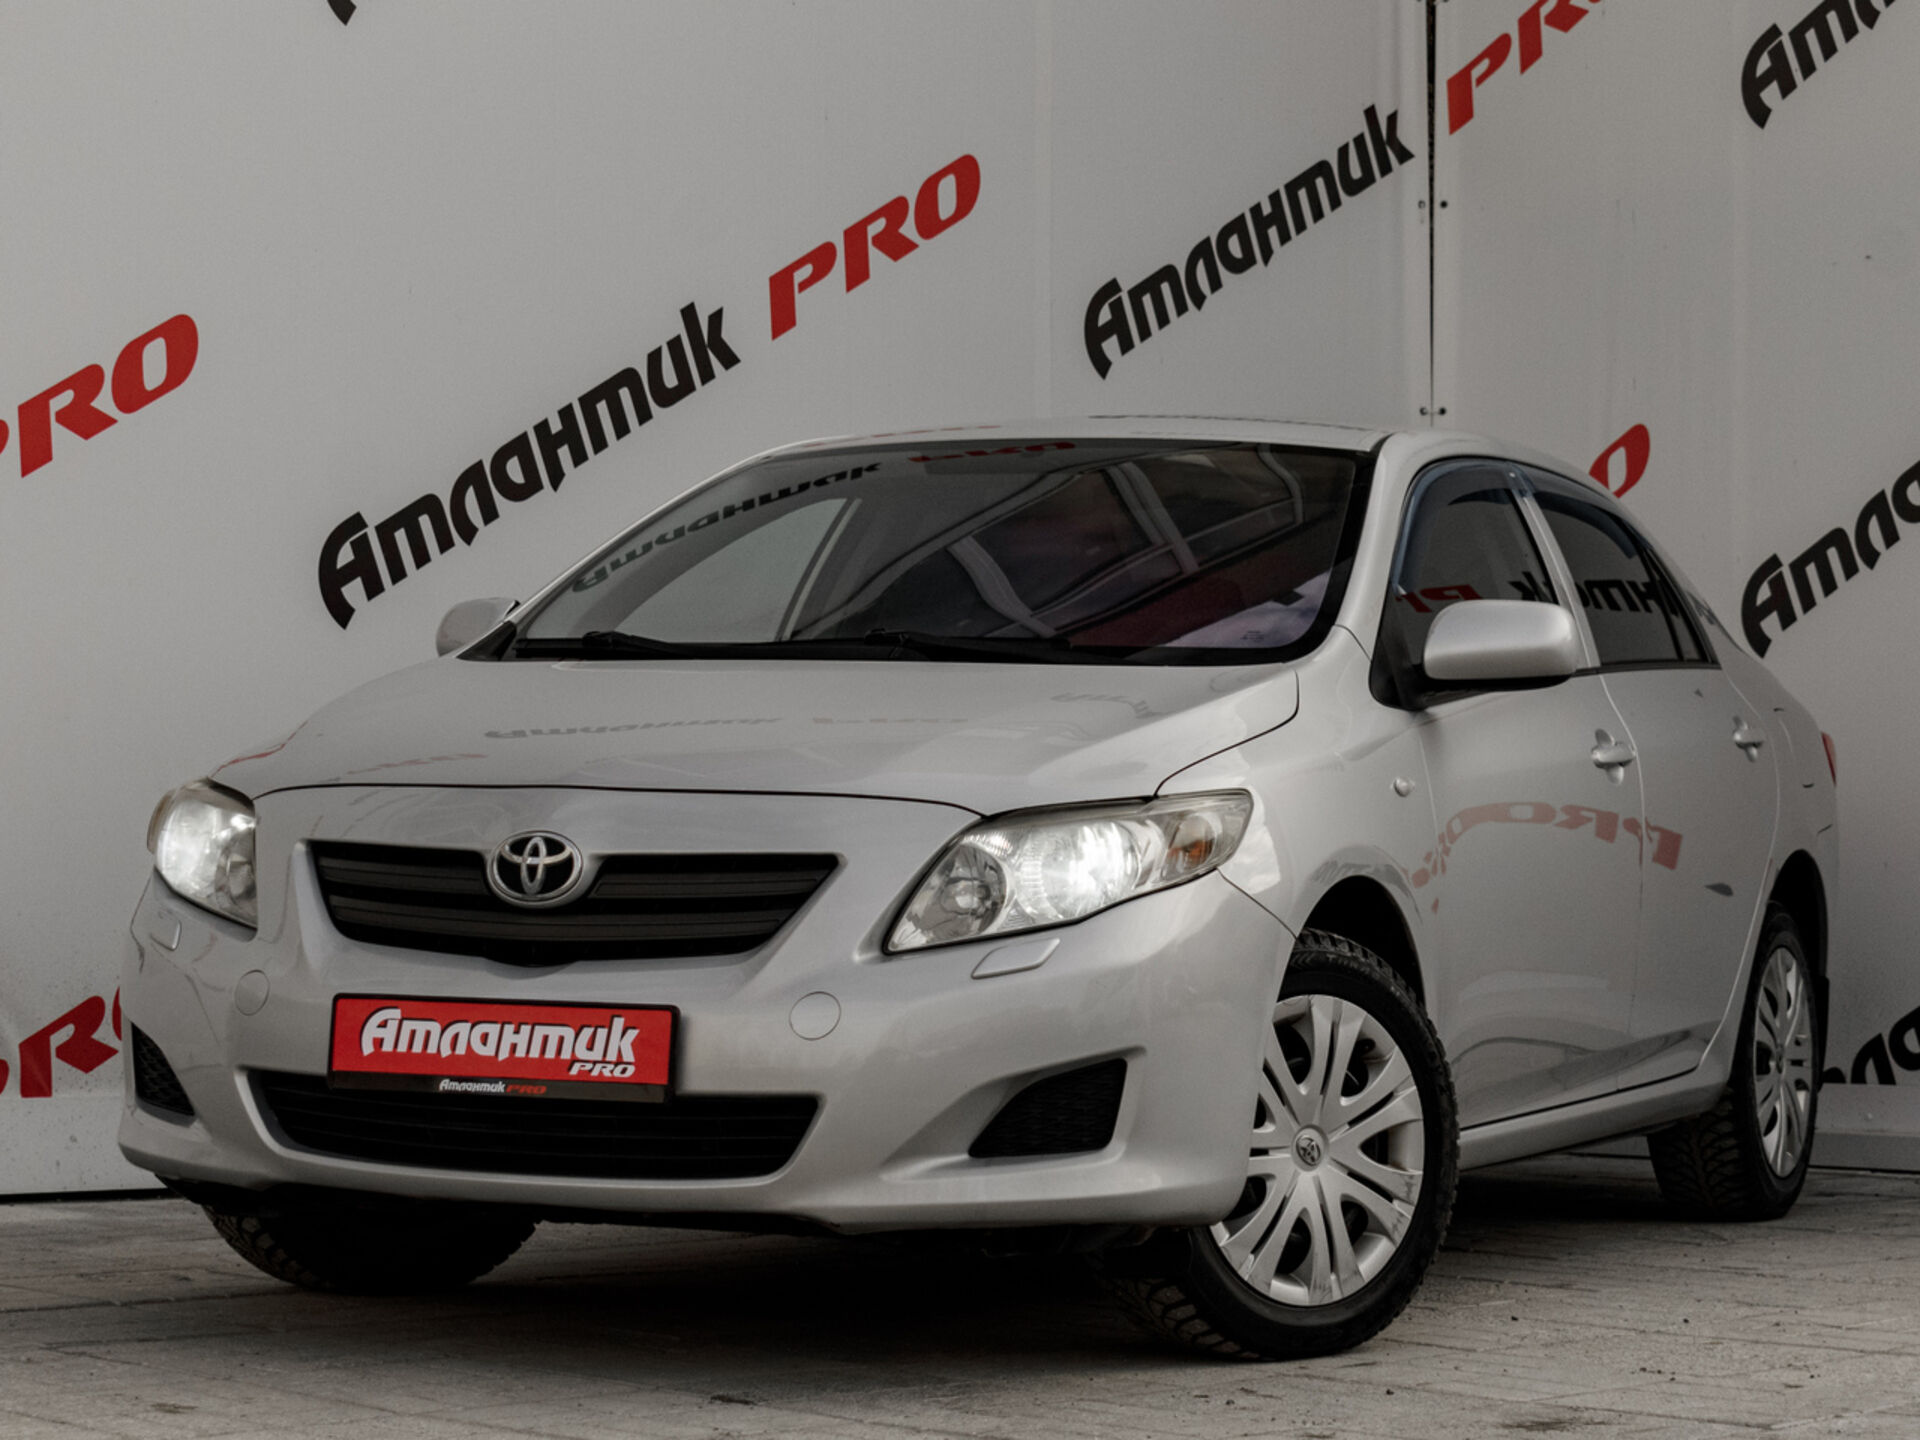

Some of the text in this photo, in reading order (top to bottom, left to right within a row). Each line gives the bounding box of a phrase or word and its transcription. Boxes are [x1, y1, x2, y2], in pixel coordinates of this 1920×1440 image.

[1084, 0, 1602, 380] Атлантик PR
[0, 313, 199, 478] RO
[318, 154, 981, 628] Атлантик PRO
[361, 1006, 639, 1062] Атлантик
[439, 1078, 548, 1096] Атлантик PRO
[568, 1060, 636, 1079] PRO
